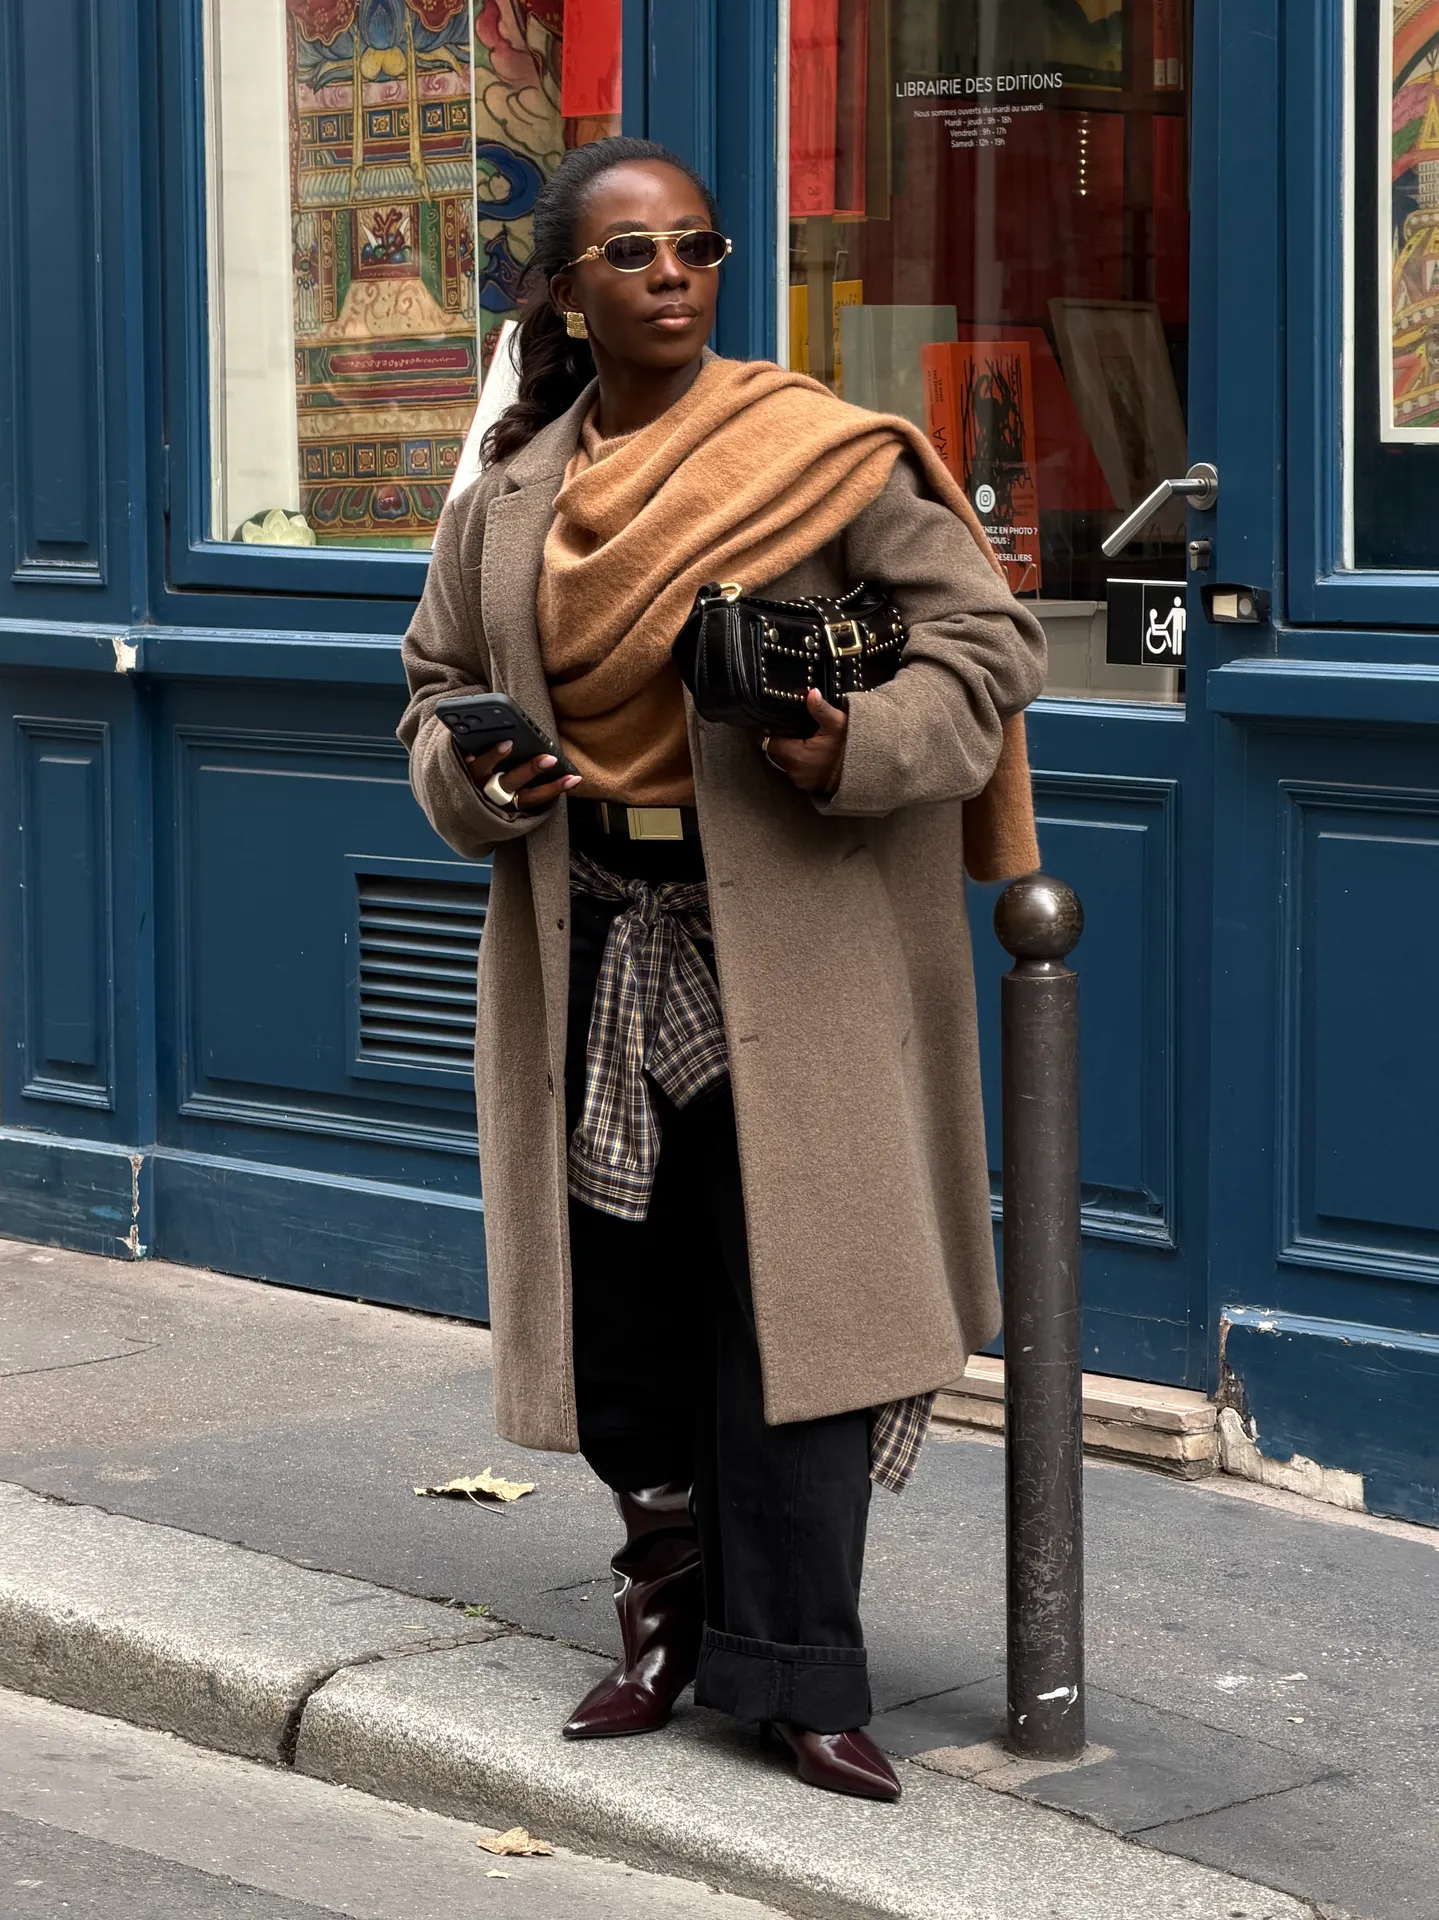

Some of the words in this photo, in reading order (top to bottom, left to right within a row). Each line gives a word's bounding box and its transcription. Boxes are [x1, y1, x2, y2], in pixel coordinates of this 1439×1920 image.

[896, 79, 962, 97] LIBRAIRIE
[965, 77, 993, 93] DES
[997, 72, 1063, 91] EDITIONS
[931, 109, 957, 117] sommes
[958, 107, 981, 115] ouverts
[983, 106, 991, 114] du
[992, 105, 1010, 113] mardi
[1021, 103, 1044, 111] samedi
[944, 119, 962, 127] Mardi
[967, 118, 983, 128] jeudi
[987, 117, 996, 125] 9h
[950, 129, 978, 137] Vendredi
[982, 128, 991, 136] 9h
[996, 127, 1007, 135] 17h
[951, 139, 974, 148] Samedi
[998, 526, 1008, 535] EN
[1009, 527, 1033, 535] PHOTO
[1034, 527, 1039, 535] ?
